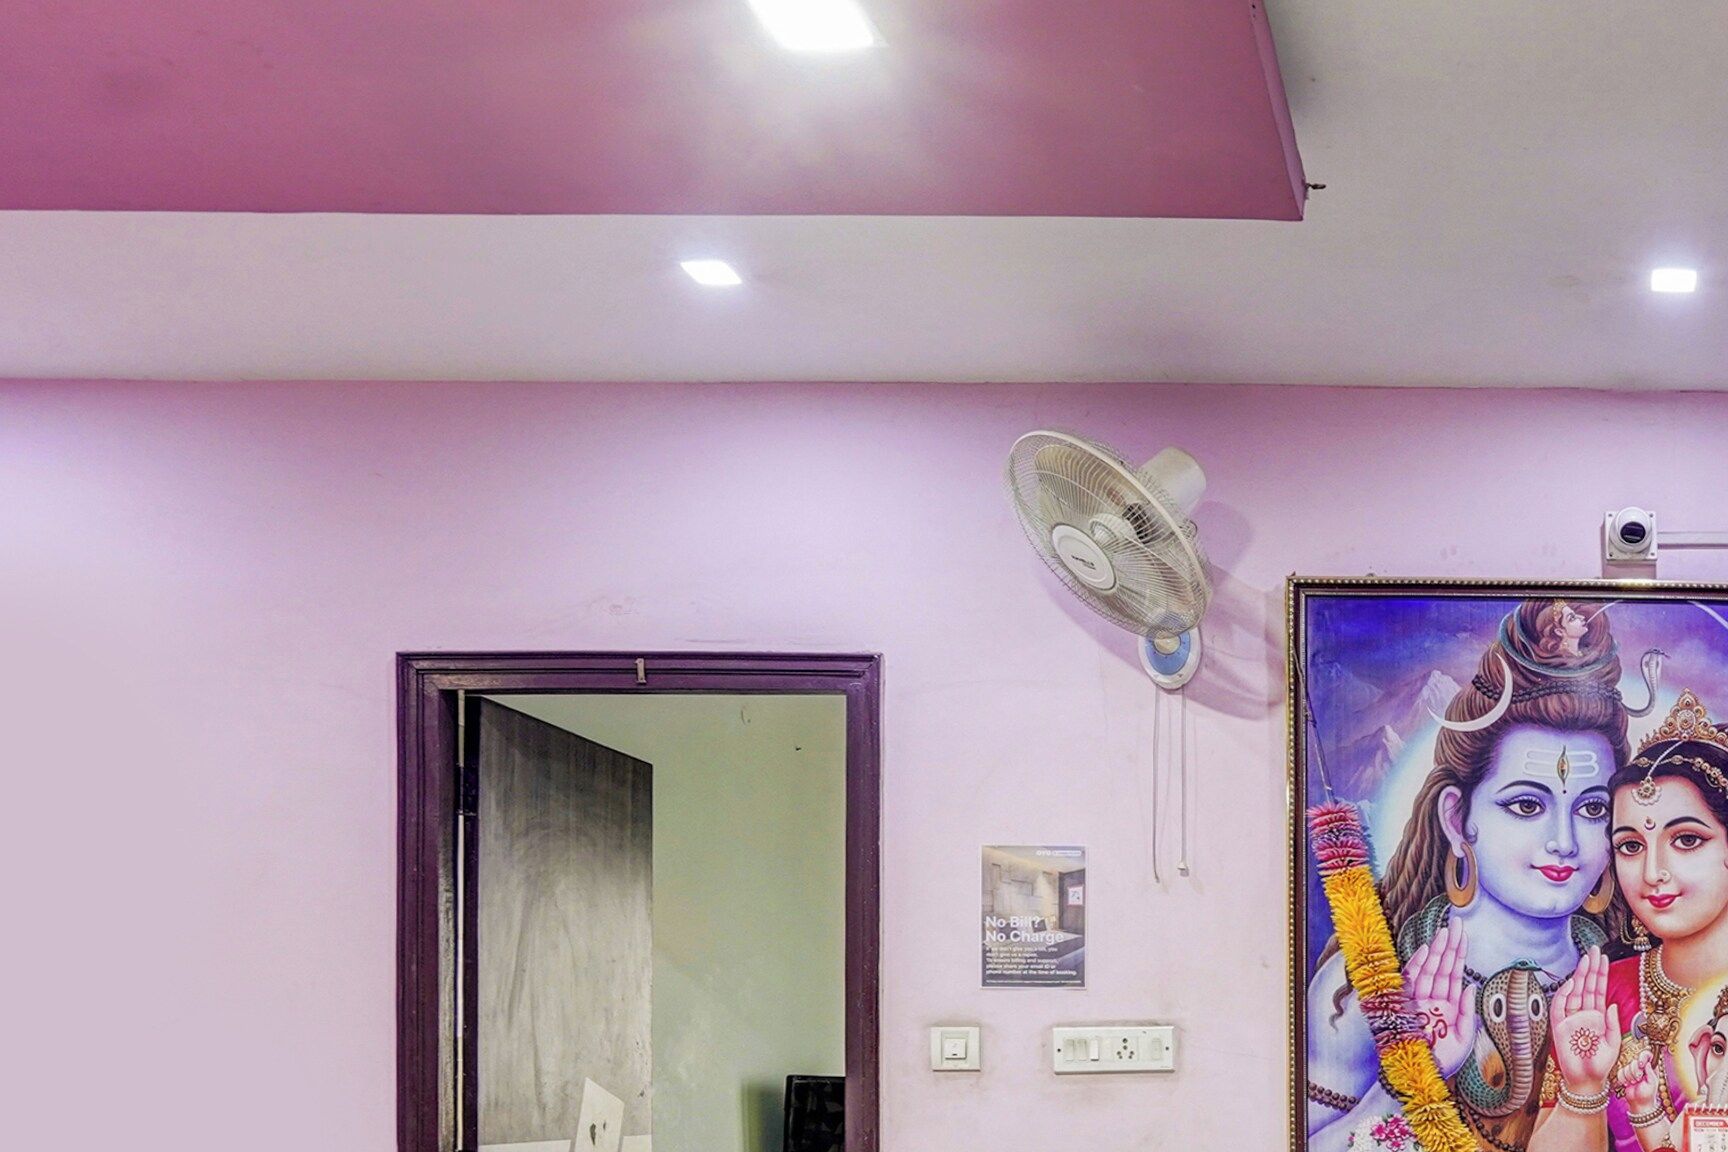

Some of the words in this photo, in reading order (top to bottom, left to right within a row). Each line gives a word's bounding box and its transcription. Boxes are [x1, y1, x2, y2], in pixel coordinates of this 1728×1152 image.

[634, 658, 646, 684] 1
[985, 916, 1006, 928] No
[1010, 915, 1040, 928] Bill?
[985, 930, 1006, 942] No
[1010, 930, 1064, 944] Charge
